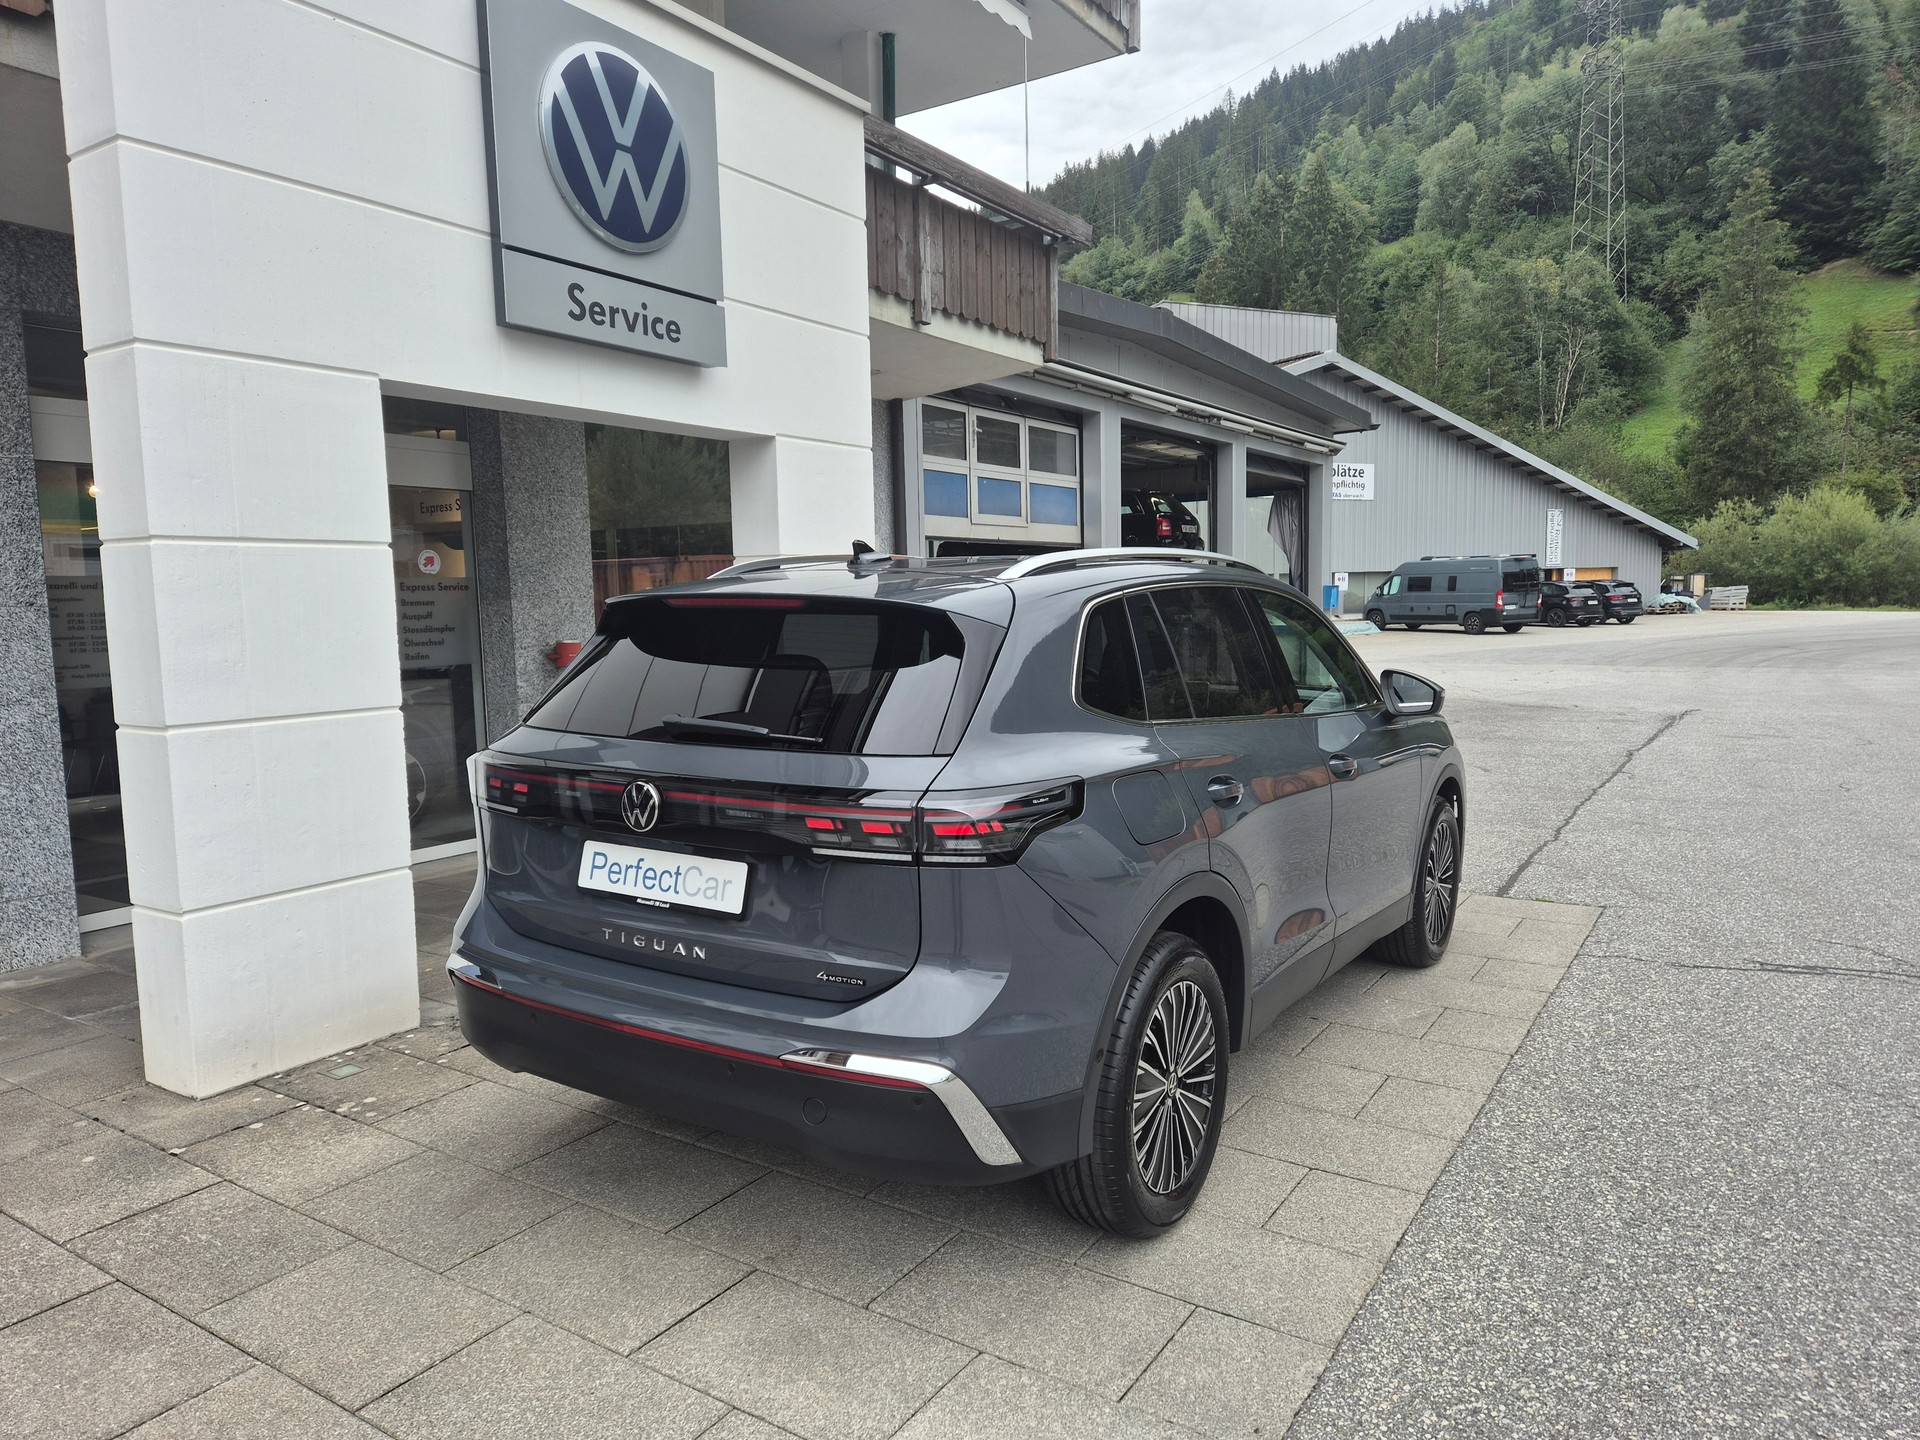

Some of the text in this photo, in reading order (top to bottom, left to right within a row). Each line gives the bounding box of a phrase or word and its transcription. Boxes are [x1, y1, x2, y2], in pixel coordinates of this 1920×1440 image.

[567, 283, 683, 345] Service
[419, 501, 453, 516] Express
[399, 582, 469, 593] Express Service
[400, 598, 435, 607] Bremsen
[401, 611, 433, 621] Auspuff
[402, 624, 456, 634] Stossdämpfer
[403, 637, 445, 648] Ölwechsel
[405, 652, 430, 661] Reifen
[588, 850, 733, 903] PerfectCar
[602, 927, 707, 960] TIGUAN
[817, 971, 864, 986] 4MOTION
